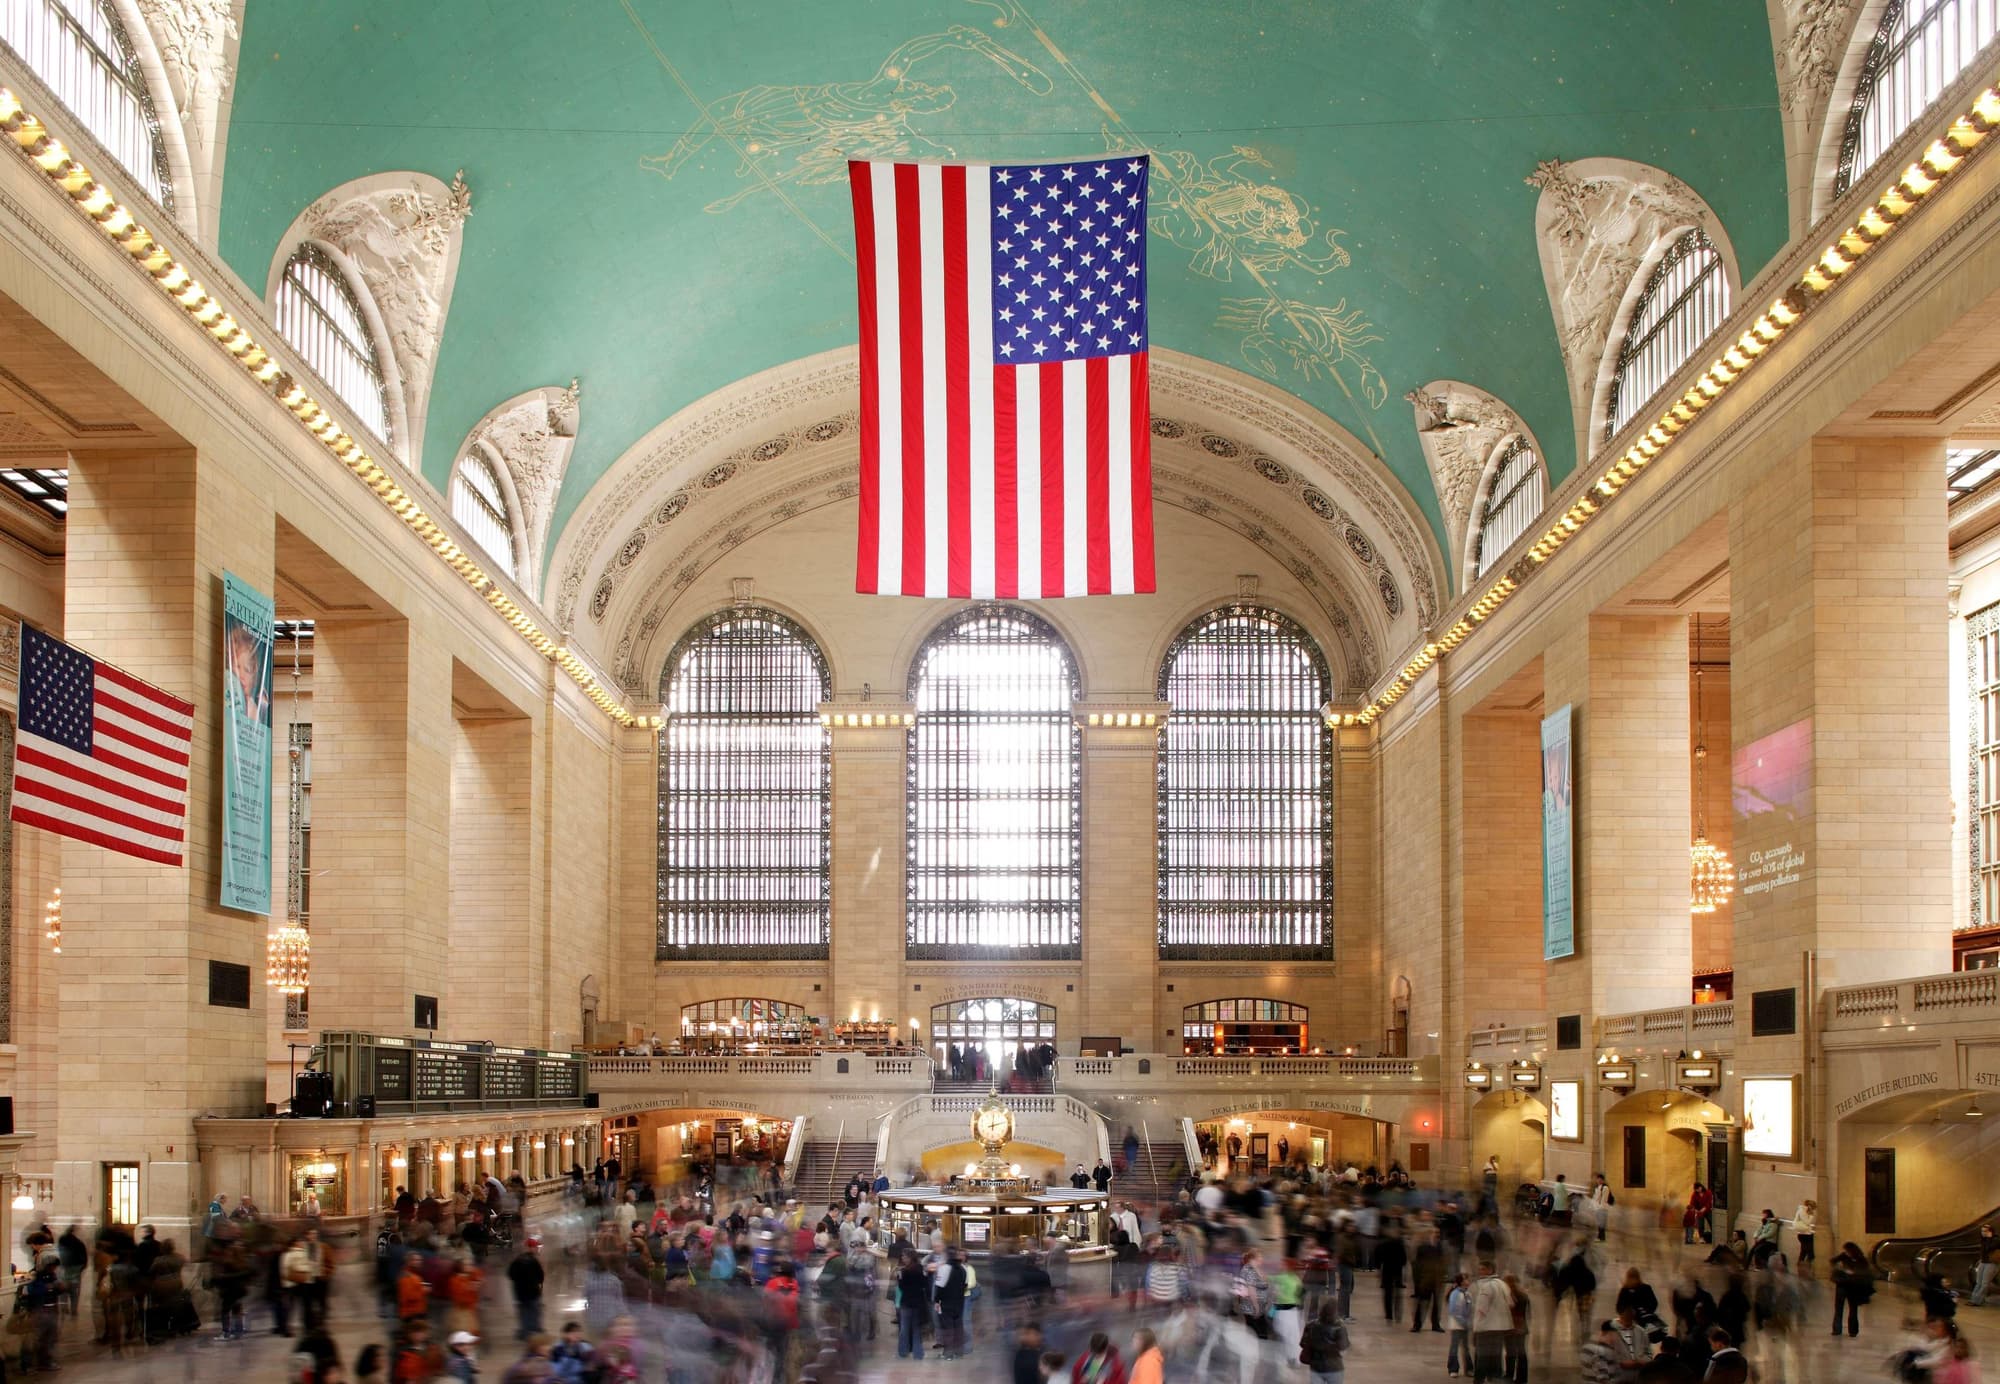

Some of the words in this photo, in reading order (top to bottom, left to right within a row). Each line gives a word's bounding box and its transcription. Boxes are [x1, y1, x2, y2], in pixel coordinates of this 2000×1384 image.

[1765, 841, 1792, 859] accounts
[1748, 868, 1761, 879] over
[1785, 850, 1805, 872] global
[1744, 880, 1769, 894] warming
[1770, 872, 1799, 891] pollution
[1834, 1097, 1854, 1115] THE
[1853, 1080, 1891, 1105] METLIFE
[1892, 1071, 1938, 1091] BUILDING
[610, 1101, 643, 1114] SUBWAY
[644, 1098, 680, 1109] SHUTTLE
[729, 1101, 760, 1111] STREET
[1309, 1100, 1340, 1109] TRACKS
